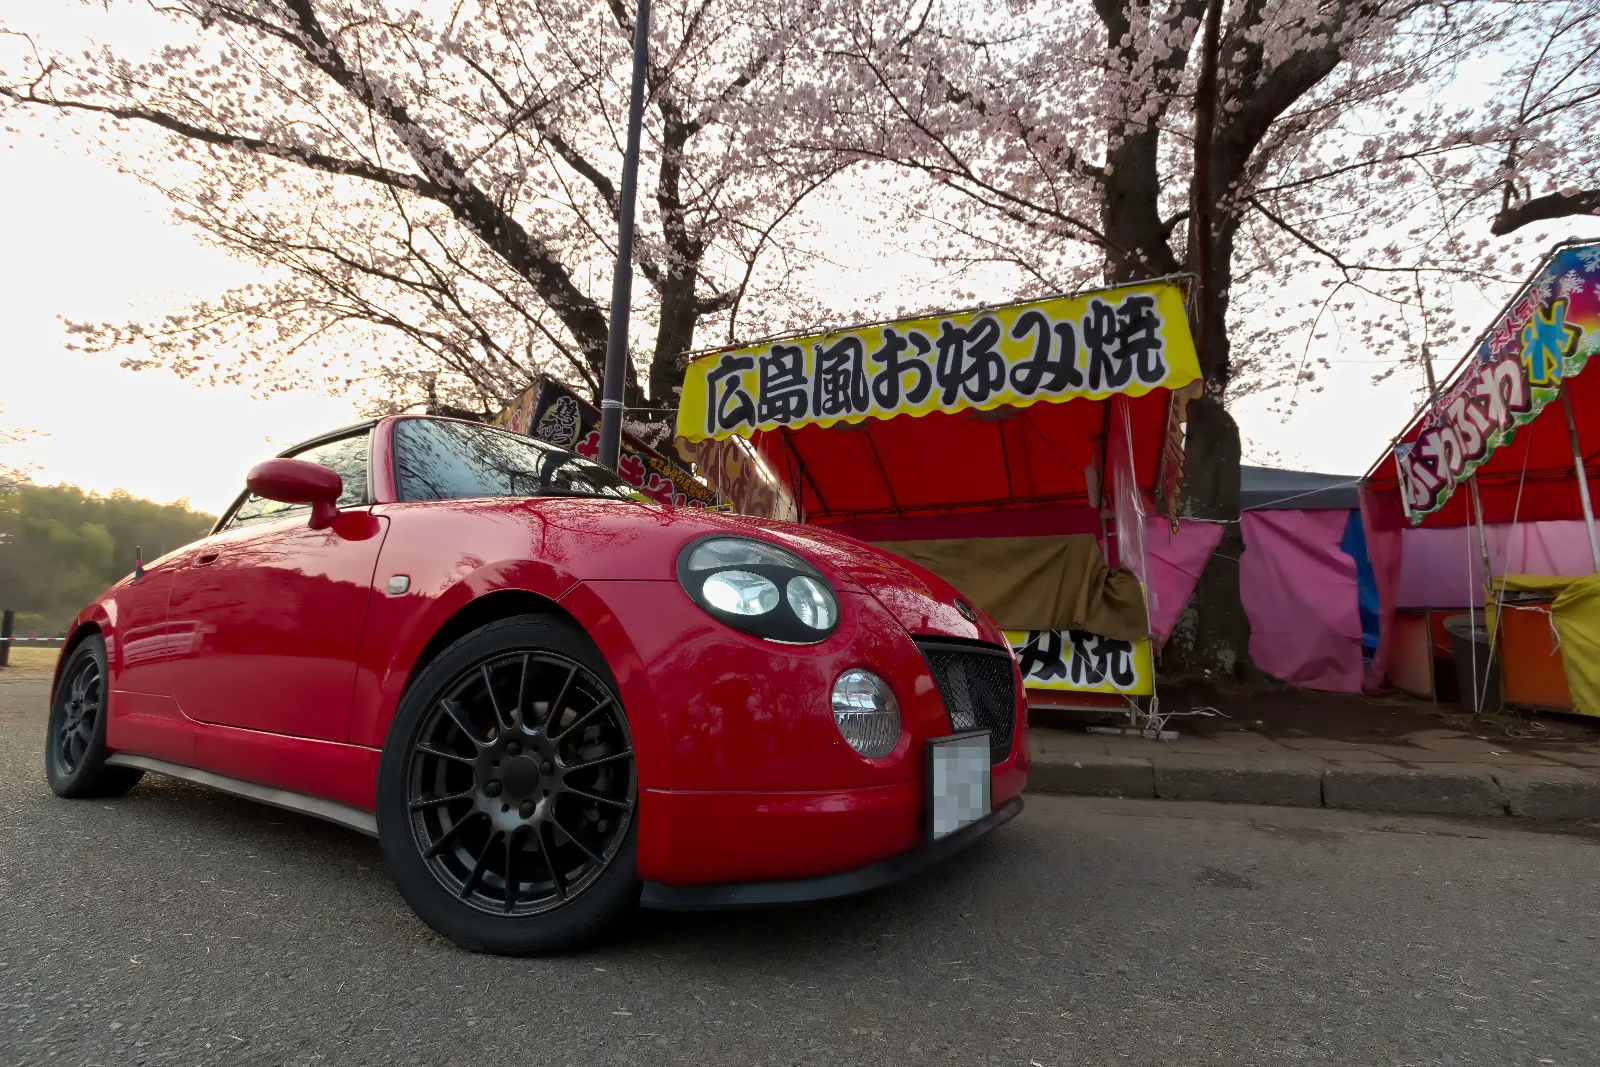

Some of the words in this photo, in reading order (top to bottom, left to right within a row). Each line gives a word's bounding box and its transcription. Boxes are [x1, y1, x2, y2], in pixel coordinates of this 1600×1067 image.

[706, 296, 1166, 434] 広島風お好み焼
